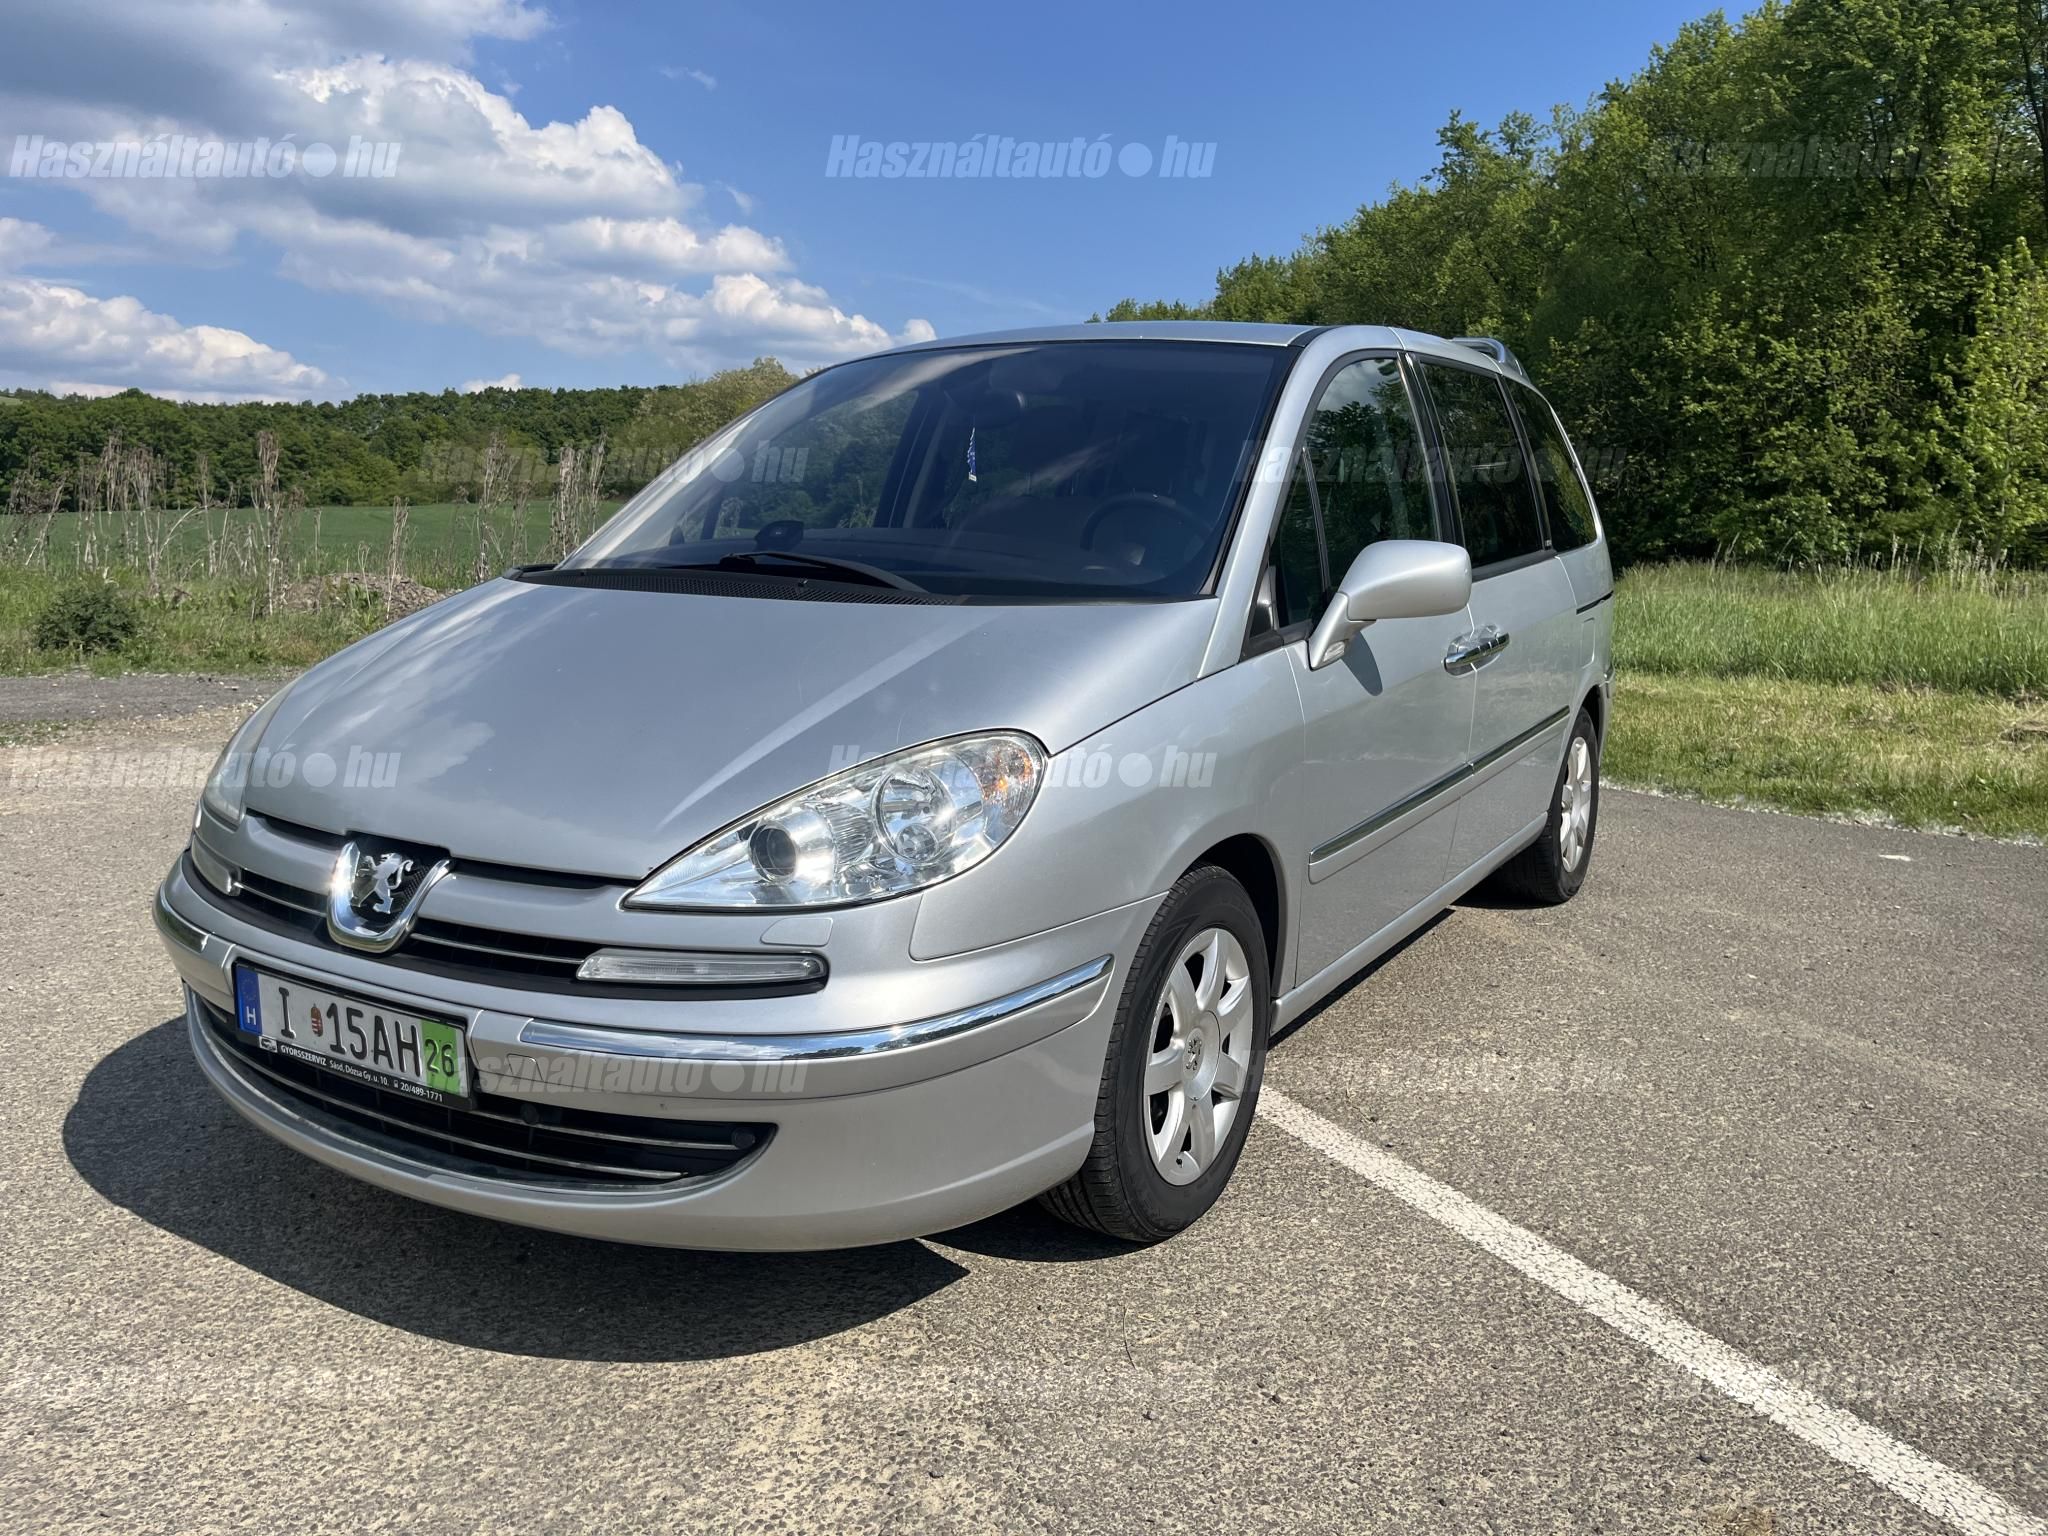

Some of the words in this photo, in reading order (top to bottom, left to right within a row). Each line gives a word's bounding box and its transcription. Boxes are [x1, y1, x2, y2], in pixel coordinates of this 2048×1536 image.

[246, 1006, 257, 1026] H
[279, 987, 296, 1039] I
[326, 1003, 422, 1077] 15AH
[425, 1038, 455, 1077] 26
[280, 1045, 327, 1066] GYORSSZERVIZ
[400, 1082, 443, 1102] 20/489-1771
